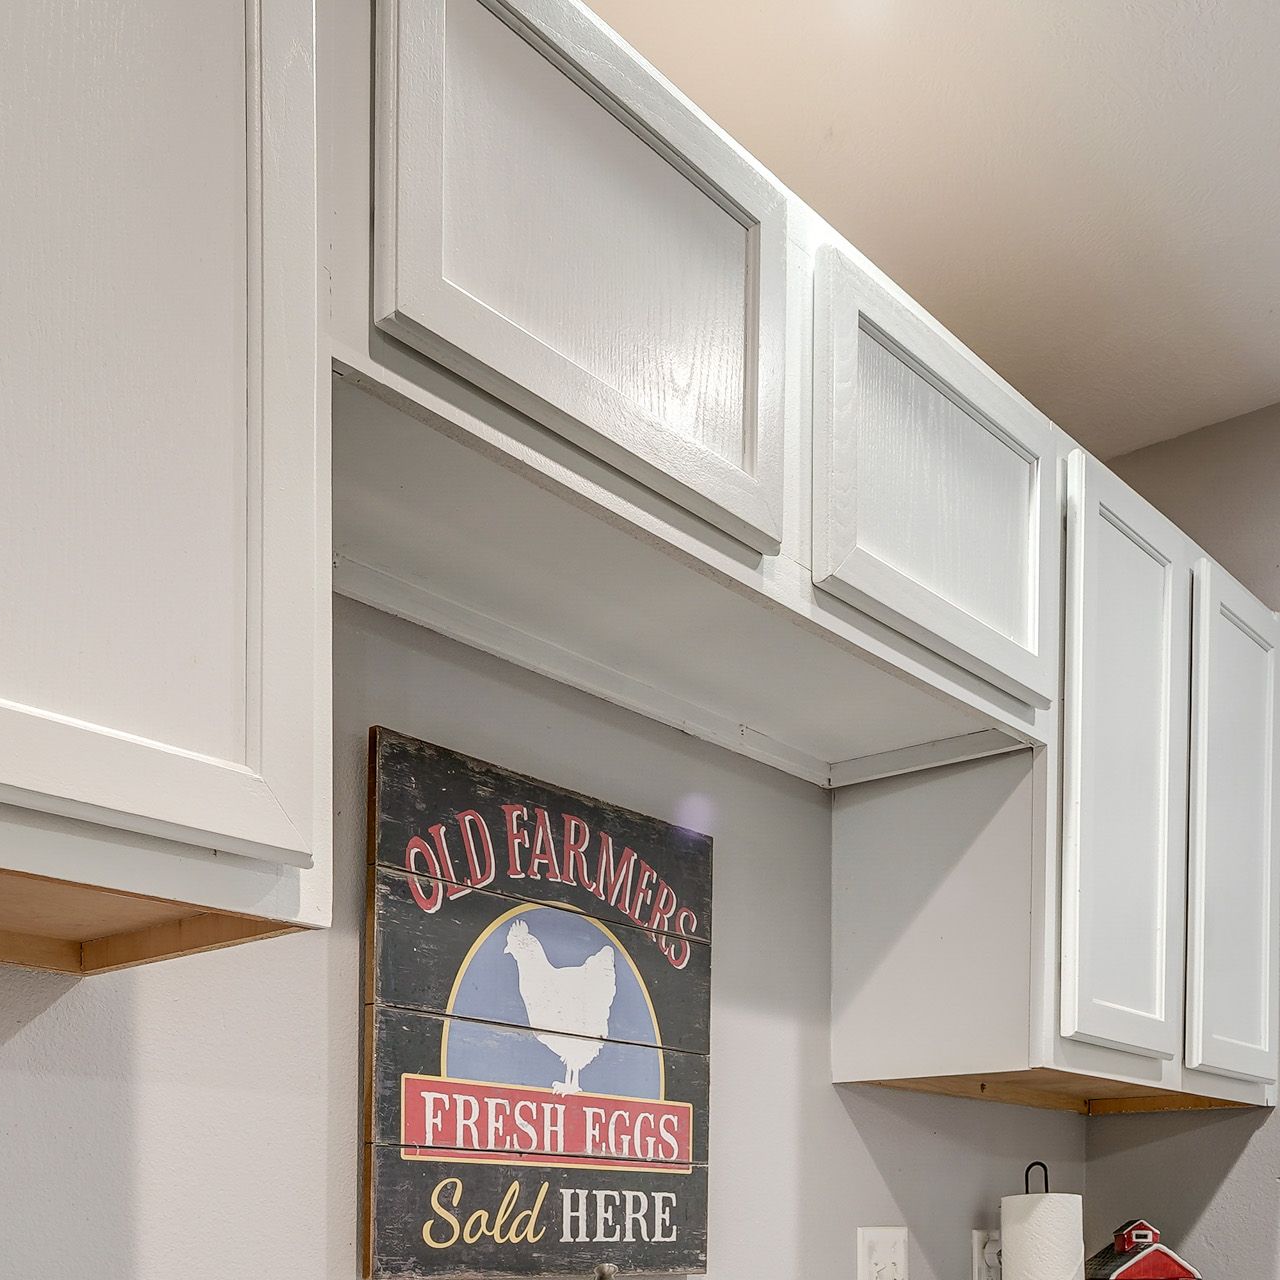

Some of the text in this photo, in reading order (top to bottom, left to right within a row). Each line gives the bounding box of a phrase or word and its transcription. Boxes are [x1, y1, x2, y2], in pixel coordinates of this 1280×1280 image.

[405, 803, 699, 971] OLD FARMERS
[421, 1091, 681, 1163] FRESH EGGS
[422, 1177, 678, 1250] Sold HERE
